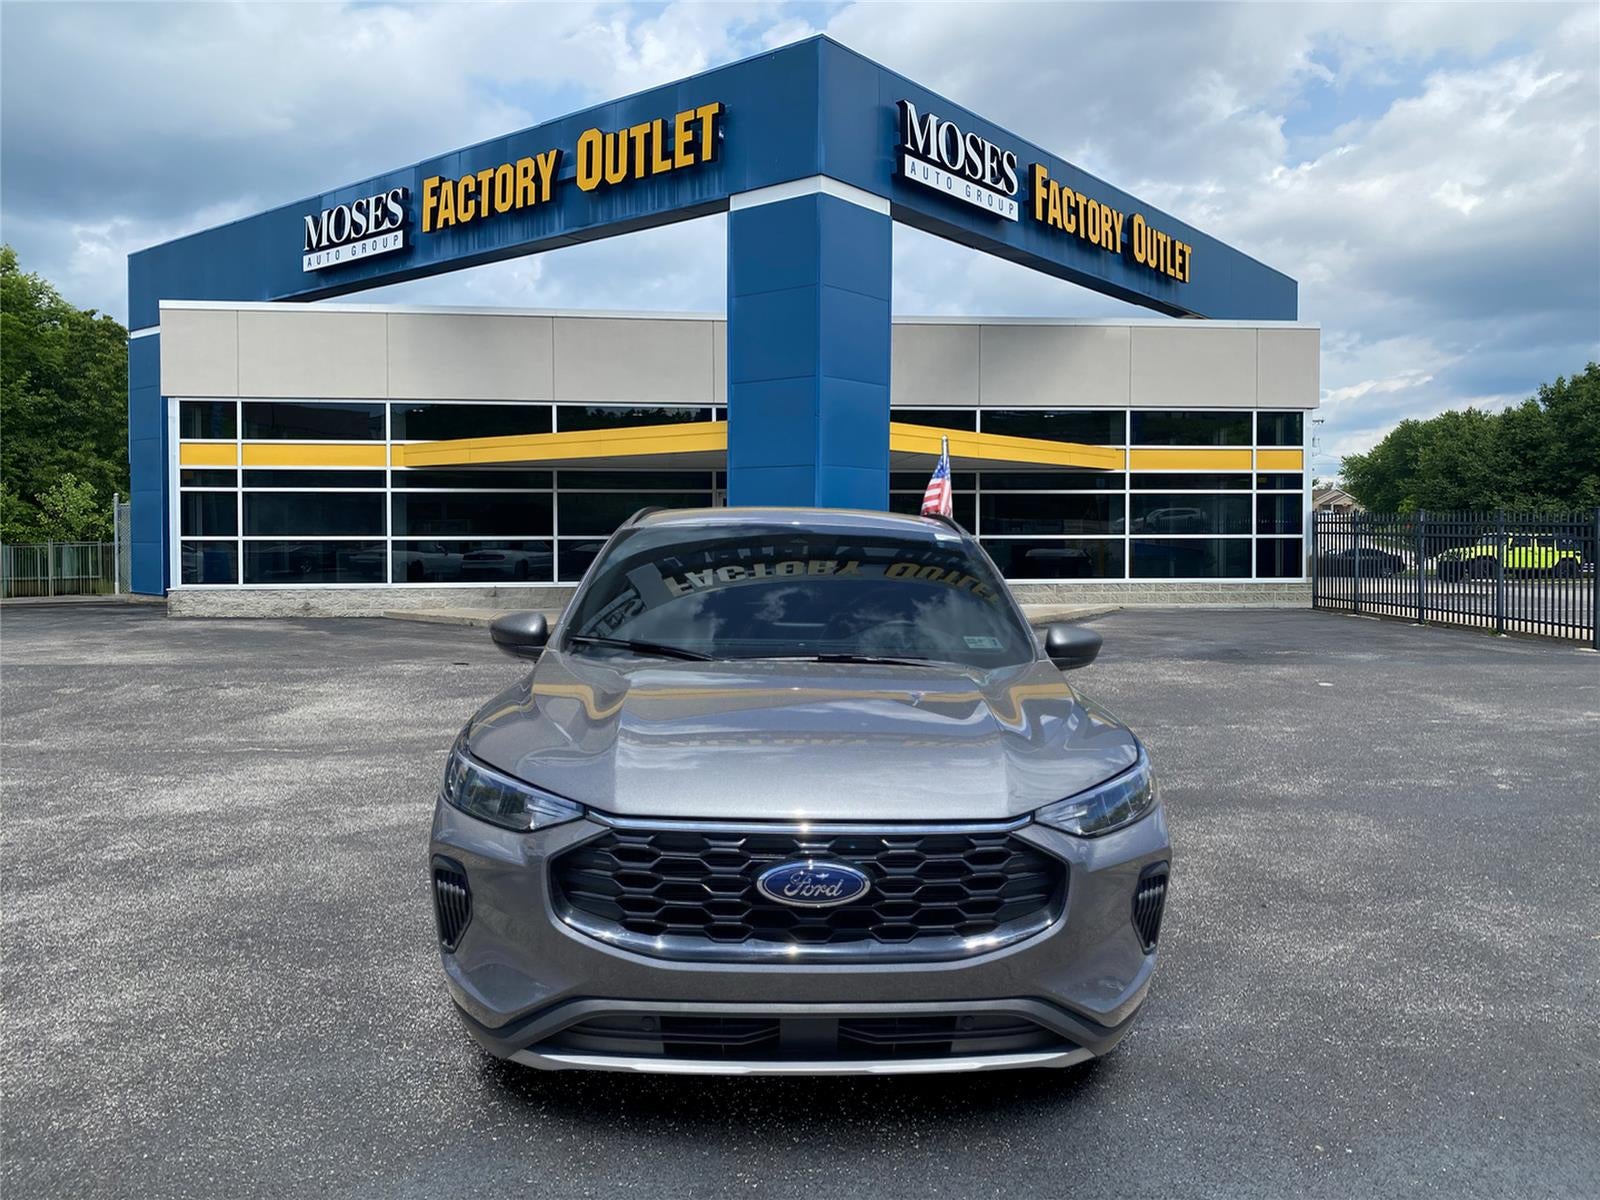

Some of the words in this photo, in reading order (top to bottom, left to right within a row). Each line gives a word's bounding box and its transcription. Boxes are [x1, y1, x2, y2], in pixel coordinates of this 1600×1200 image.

[421, 149, 558, 233] FACTORY
[576, 102, 720, 192] OUTLET
[903, 100, 1018, 196] MOSES
[303, 187, 404, 251] MOSES
[910, 161, 952, 190] AUTO
[965, 184, 1014, 215] GROUP
[307, 249, 340, 268] AUTO
[351, 234, 399, 257] GROUP
[1034, 163, 1124, 254] FACTORY
[1132, 212, 1192, 284] OUTLET
[783, 871, 844, 897] Ford
